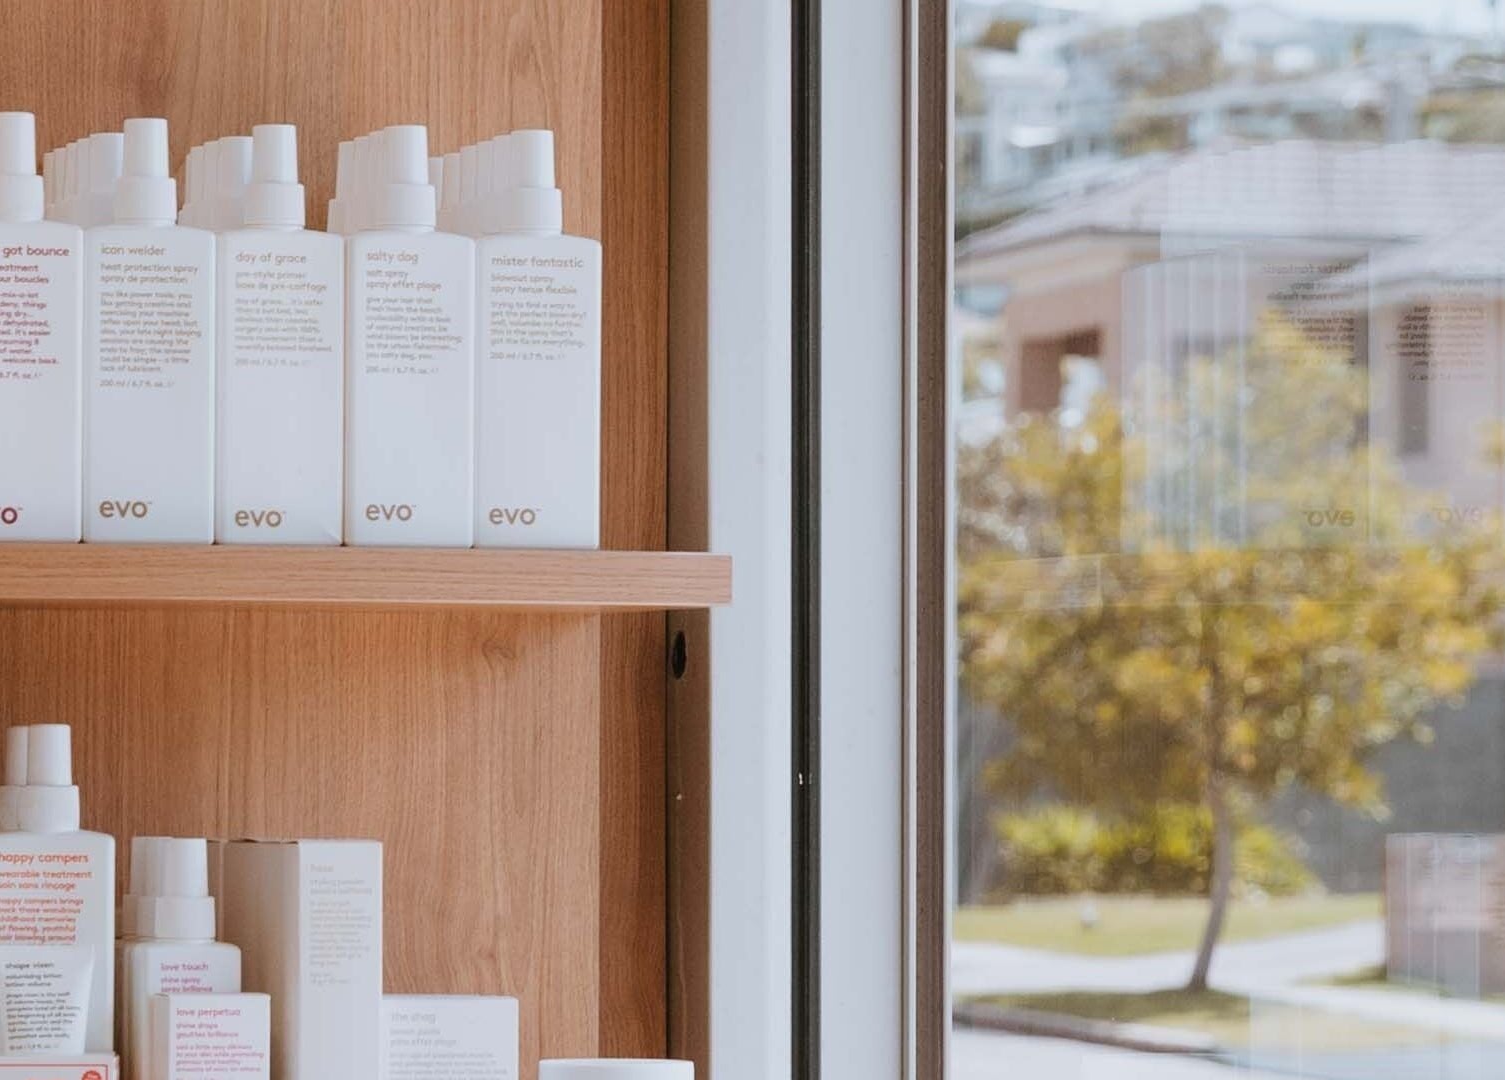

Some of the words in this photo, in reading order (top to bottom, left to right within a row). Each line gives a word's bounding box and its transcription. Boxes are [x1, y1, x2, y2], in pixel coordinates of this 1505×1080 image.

[2, 246, 23, 258] got
[26, 245, 70, 256] bounce
[101, 244, 125, 255] icon
[127, 245, 166, 256] welder
[235, 252, 257, 264] day
[259, 252, 272, 263] of
[275, 255, 307, 266] grace
[366, 251, 395, 264] salty
[396, 251, 419, 265] dog
[491, 255, 528, 266] mister
[530, 256, 583, 268] fantastic
[13, 275, 49, 284] boucles
[99, 501, 148, 518] evo
[366, 504, 412, 521] evo
[235, 510, 282, 528] evo
[489, 508, 536, 525] evo
[37, 854, 89, 865] campers
[42, 871, 92, 879] treatment
[161, 963, 180, 971] love
[182, 963, 209, 971] touch
[176, 1008, 196, 1016] love
[197, 1009, 241, 1018] perpetua
